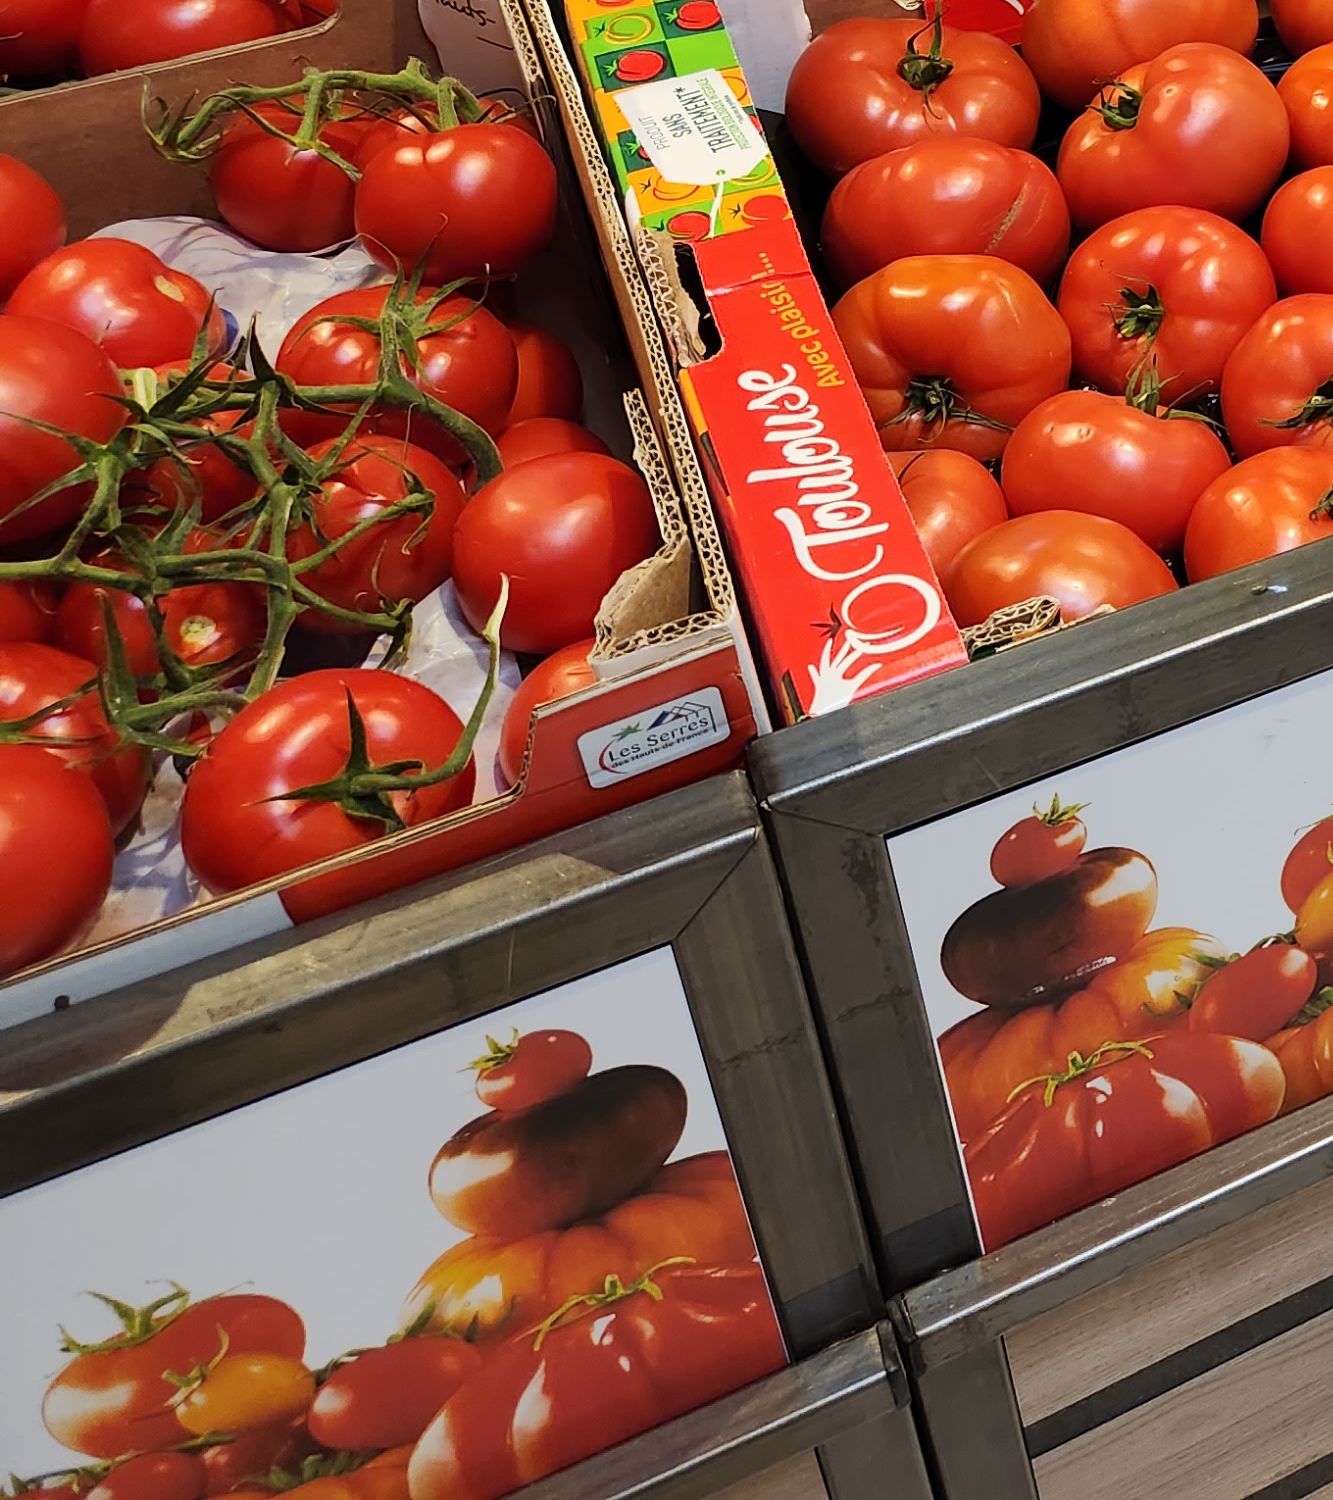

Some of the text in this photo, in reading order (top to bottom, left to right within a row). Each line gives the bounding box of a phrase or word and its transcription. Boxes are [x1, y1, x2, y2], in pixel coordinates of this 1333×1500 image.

[638, 116, 671, 151] PRODUIT
[662, 113, 693, 139] SANS
[799, 342, 846, 388] Avec
[737, 364, 889, 581] Toulouse
[608, 716, 709, 762] Les Serres
[611, 728, 709, 769] des Hauts-de-France
